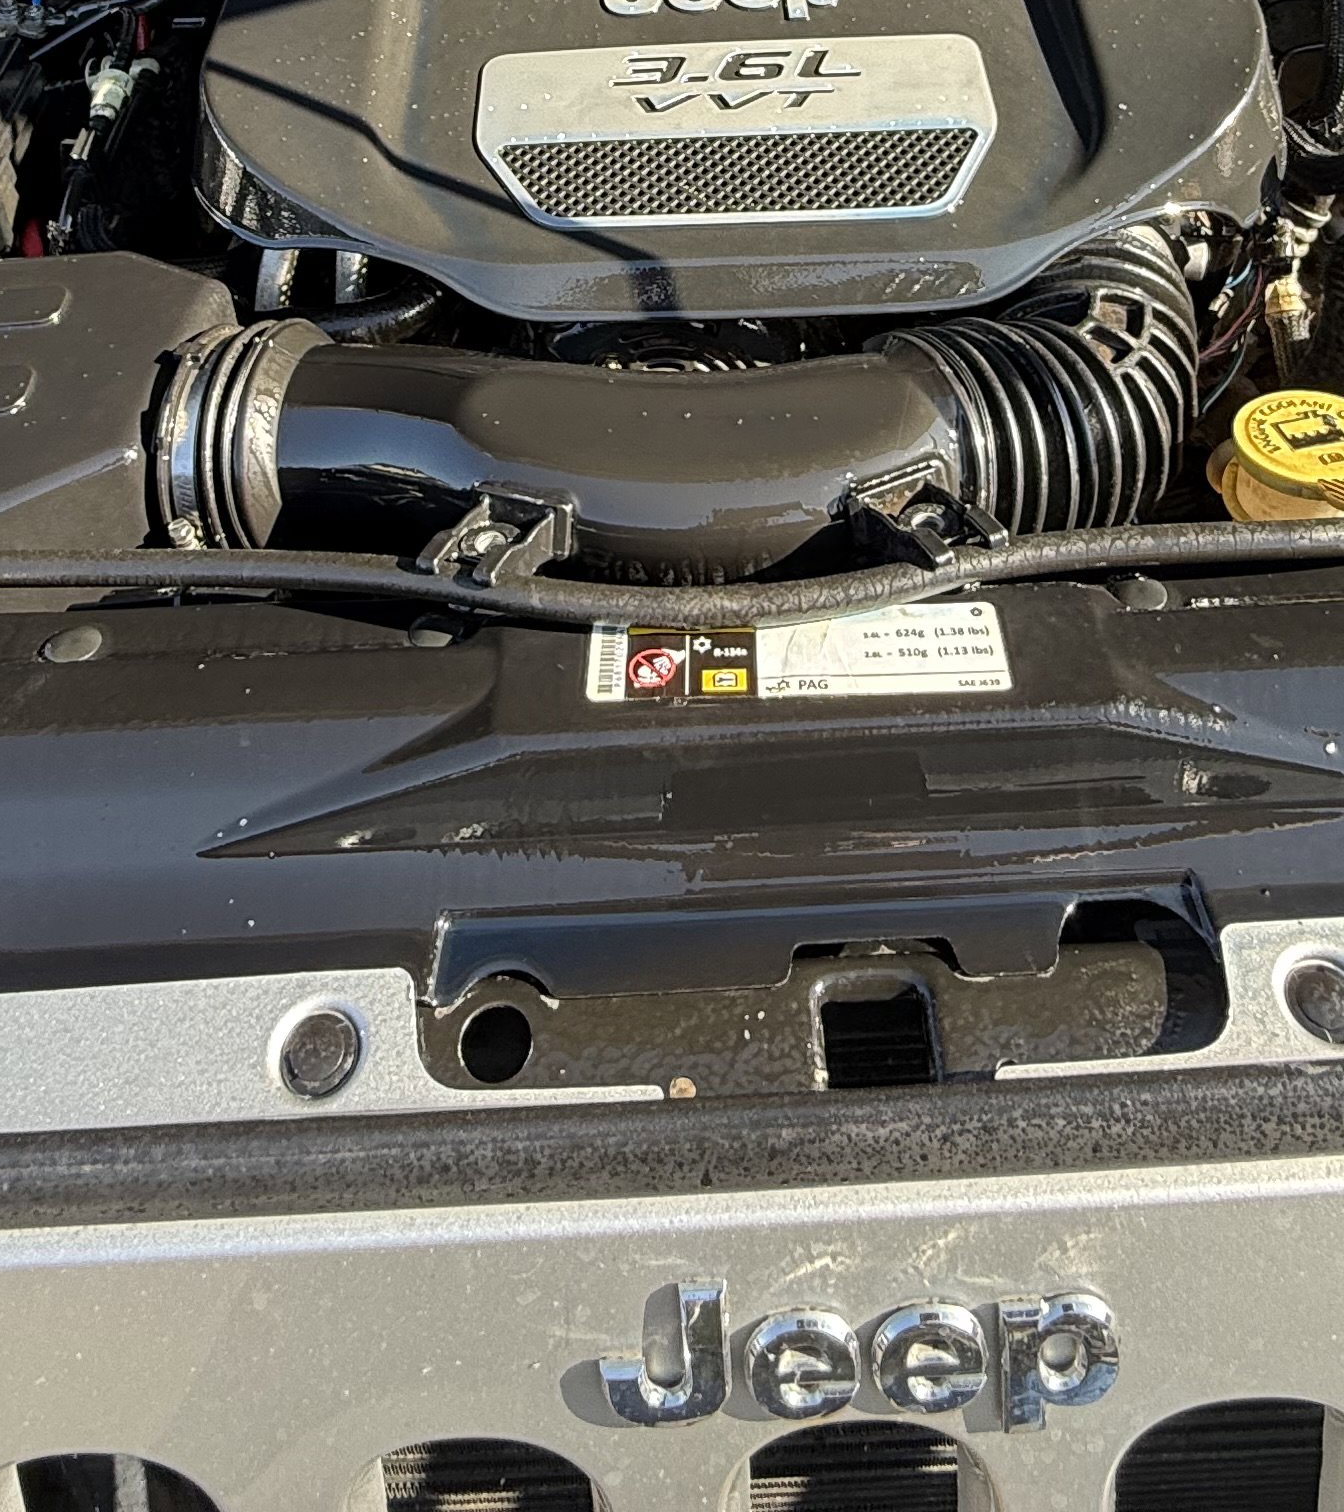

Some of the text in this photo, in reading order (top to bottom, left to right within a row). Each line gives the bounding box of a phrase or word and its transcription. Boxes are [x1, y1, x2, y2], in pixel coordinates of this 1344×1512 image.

[608, 46, 862, 87] 3.6L
[631, 85, 835, 113] VVT
[895, 628, 926, 639] 624g
[934, 626, 965, 639] (1.38
[967, 625, 991, 637] lbs)
[898, 647, 929, 659] 510g
[937, 645, 968, 658] (1.13
[971, 644, 995, 657] lbs)
[798, 679, 829, 691] PAG
[599, 1278, 1120, 1434] Jeep
